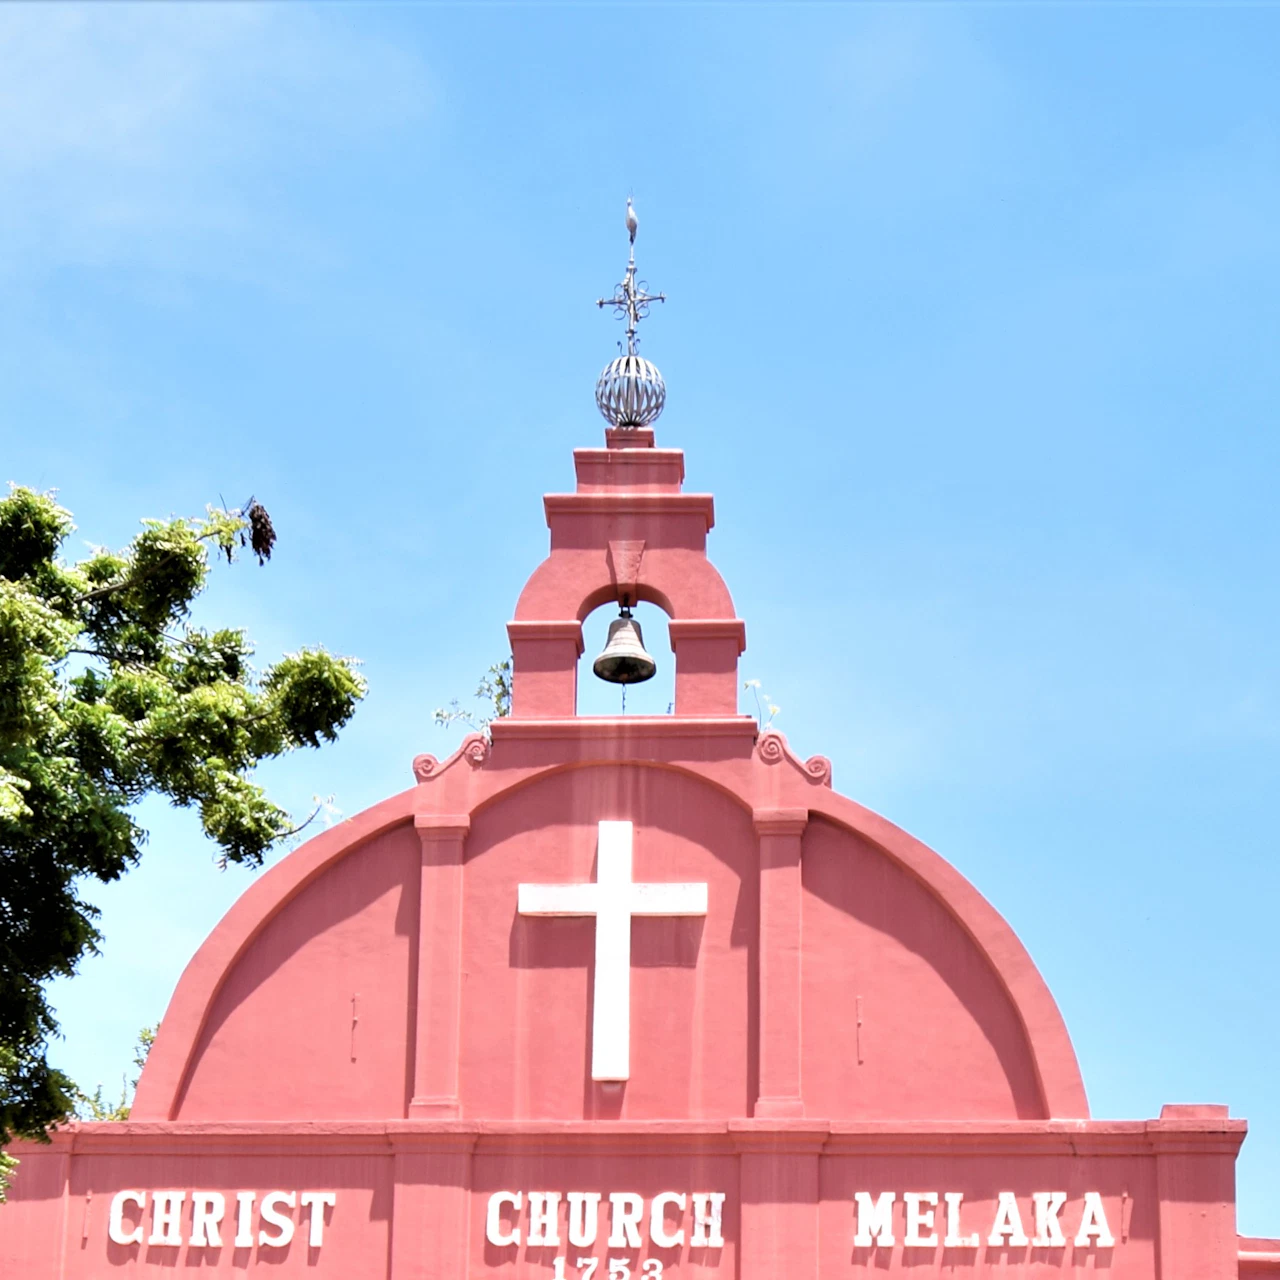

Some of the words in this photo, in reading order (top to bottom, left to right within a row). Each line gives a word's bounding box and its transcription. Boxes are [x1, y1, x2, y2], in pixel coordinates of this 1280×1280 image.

[108, 1190, 337, 1248] CHRIST
[486, 1190, 726, 1249] CHURCH
[854, 1191, 1116, 1248] MELAKA
